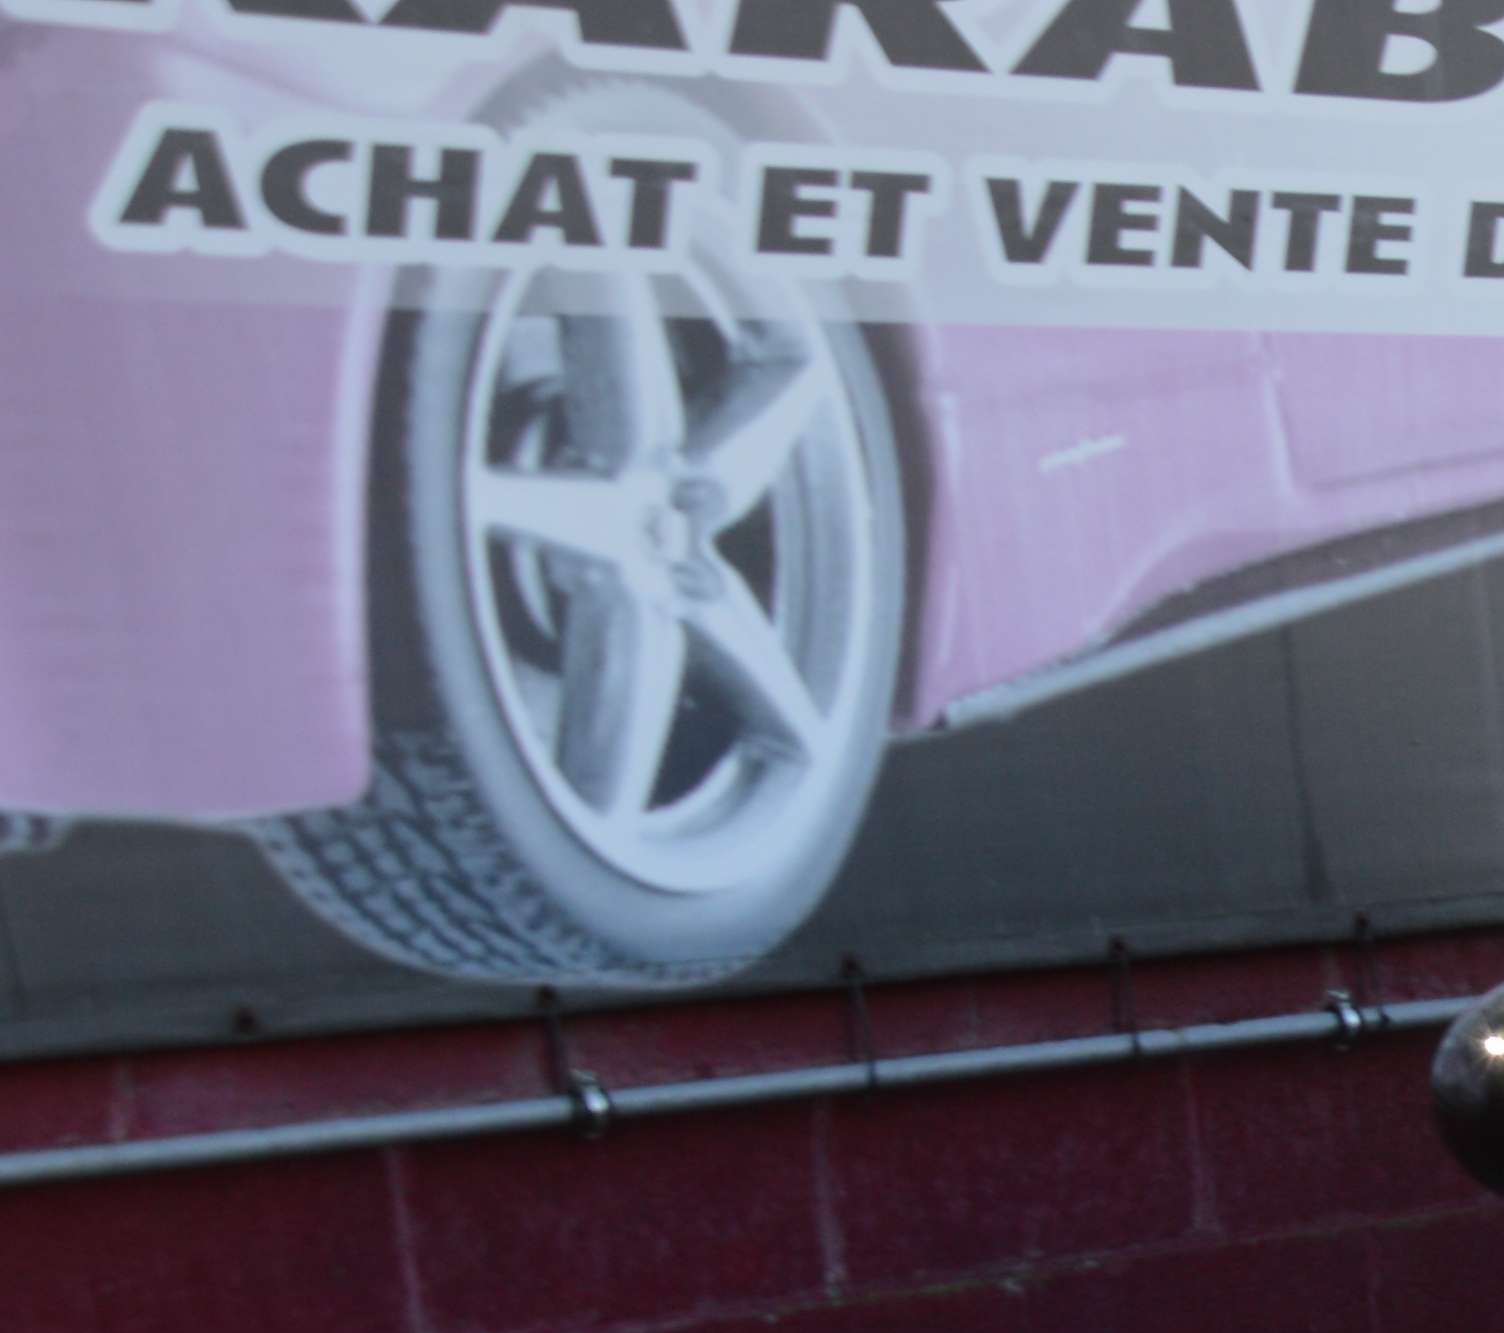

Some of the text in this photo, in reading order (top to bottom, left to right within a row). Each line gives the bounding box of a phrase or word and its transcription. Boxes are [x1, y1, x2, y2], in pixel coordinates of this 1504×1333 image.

[118, 127, 698, 250] ACHAT
[756, 166, 931, 259] ET
[984, 177, 1416, 276] VENTE
